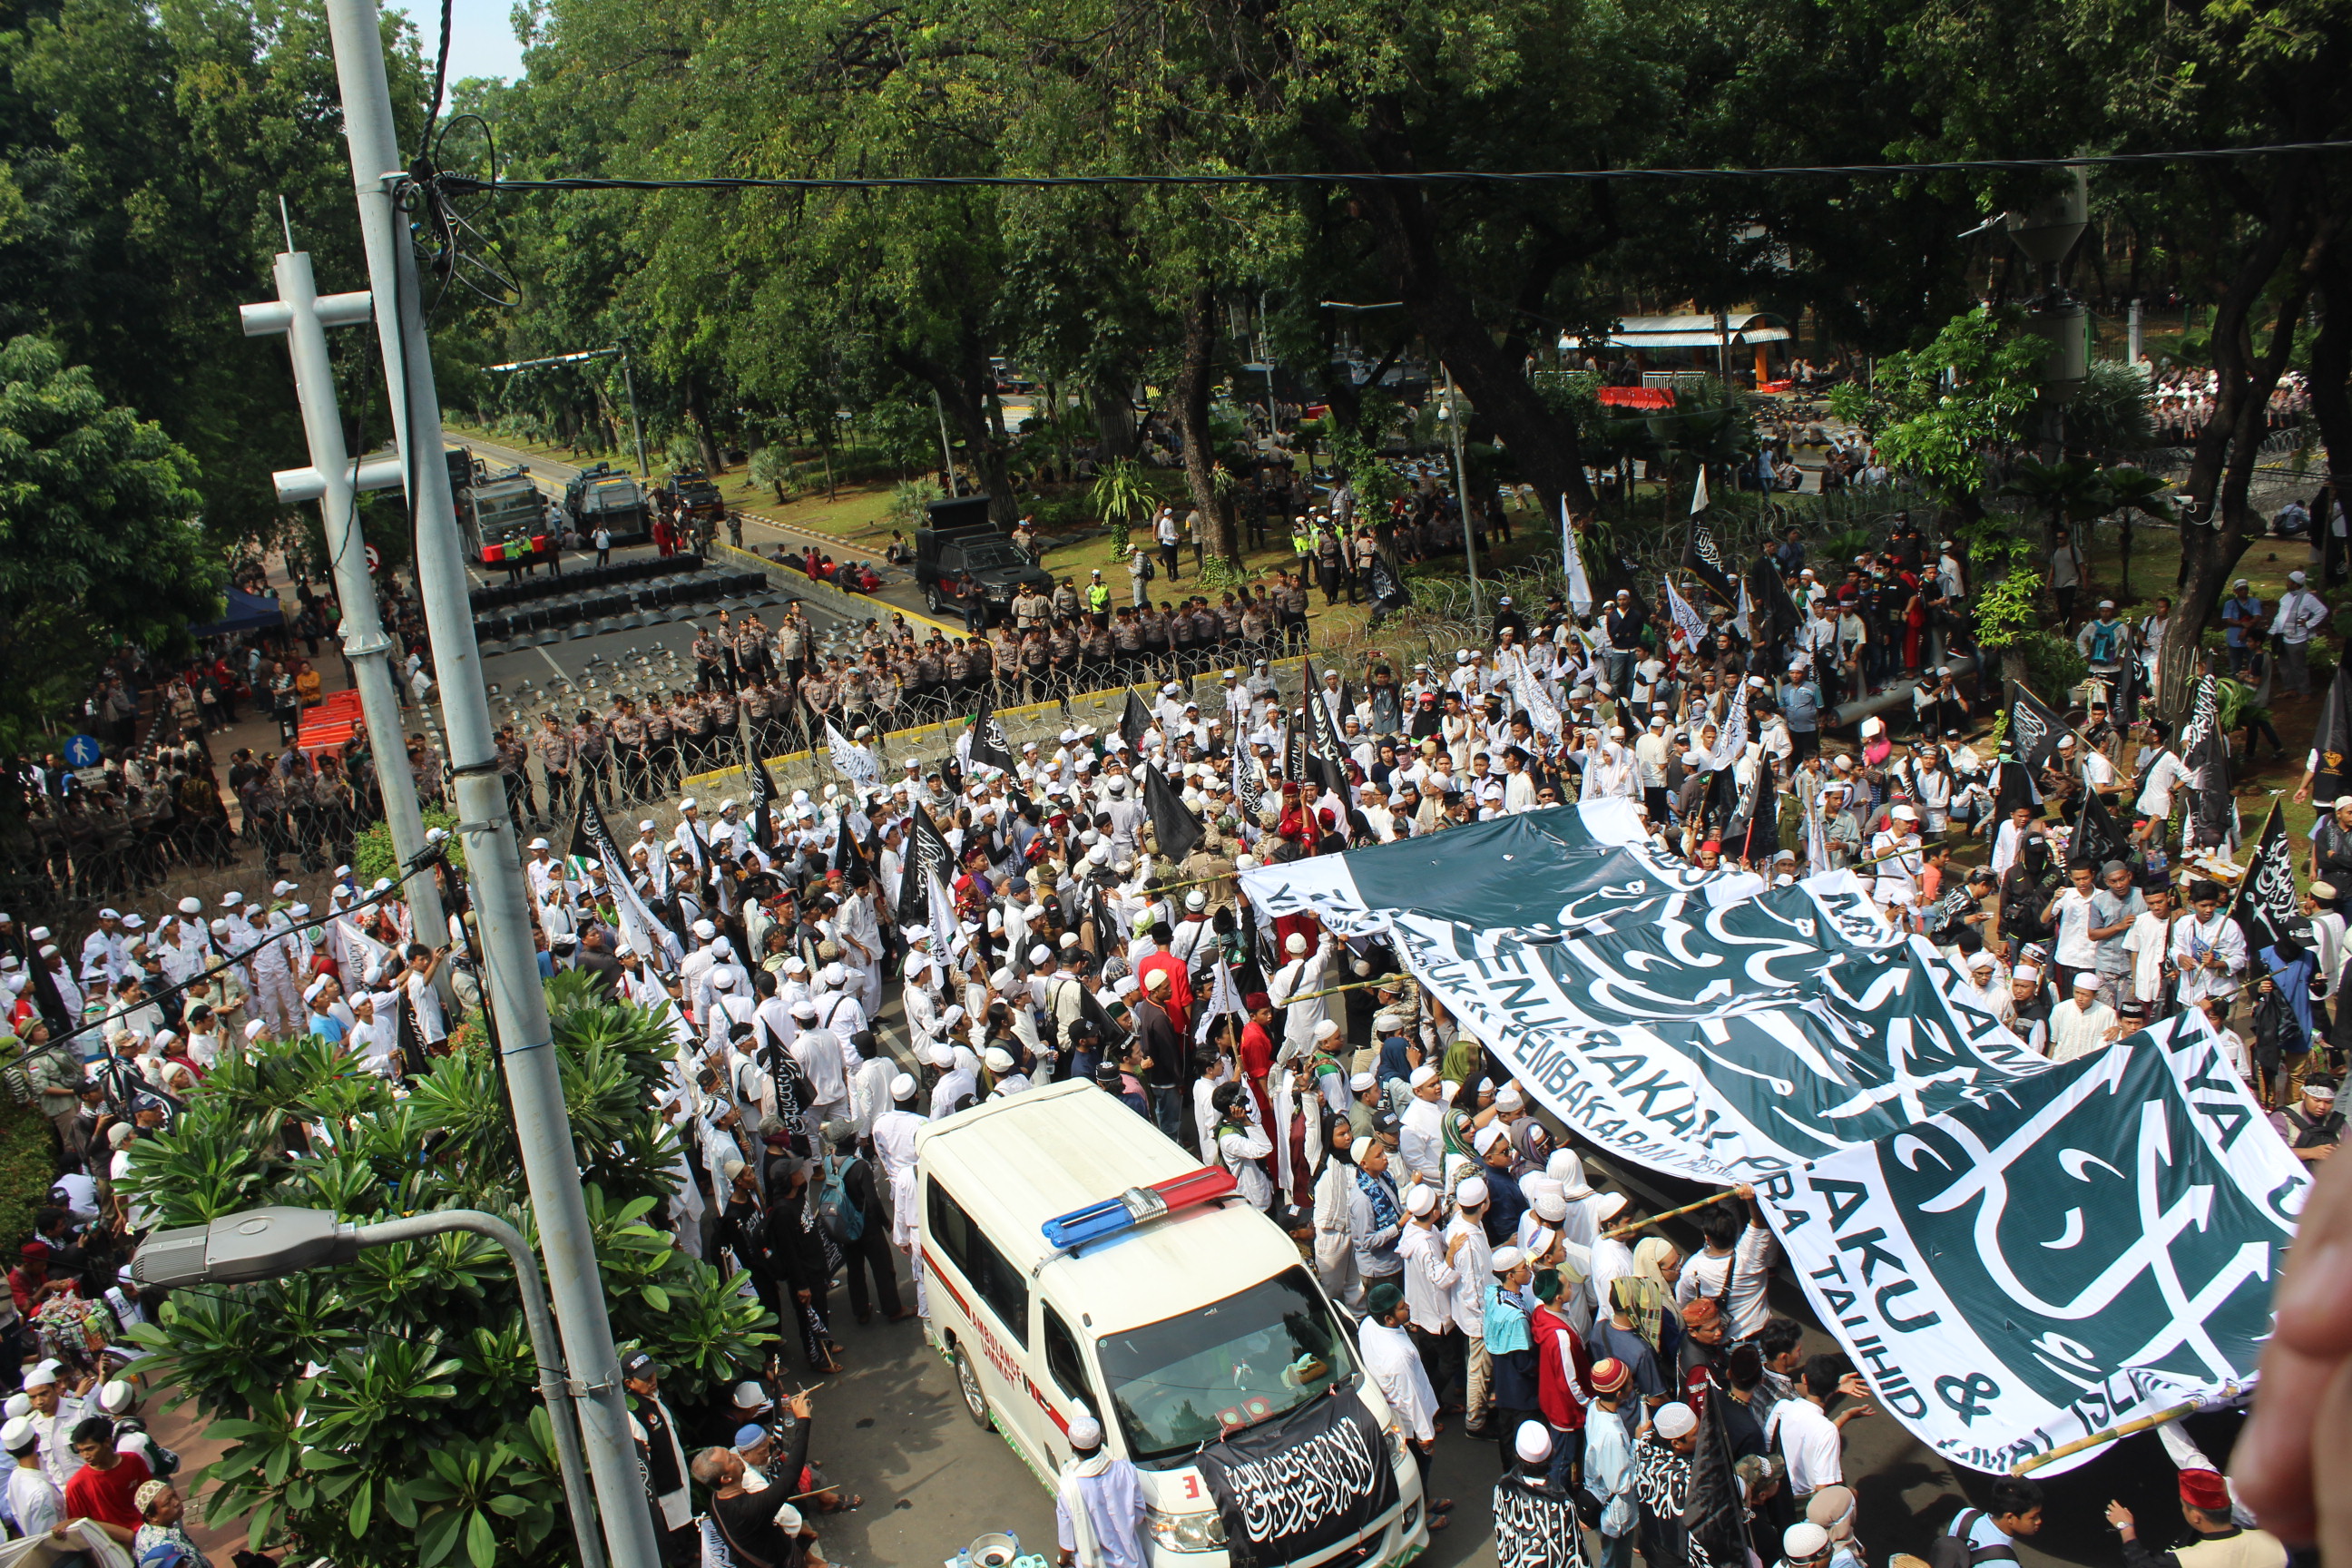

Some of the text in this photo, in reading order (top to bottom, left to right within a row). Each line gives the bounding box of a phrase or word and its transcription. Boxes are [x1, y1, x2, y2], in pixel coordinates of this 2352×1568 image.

[972, 1310, 1022, 1383] AMBULANCE
[980, 1336, 1015, 1391] UMMAT
[1808, 1254, 1927, 1420] TAUHID
[1934, 1371, 2002, 1428] &
